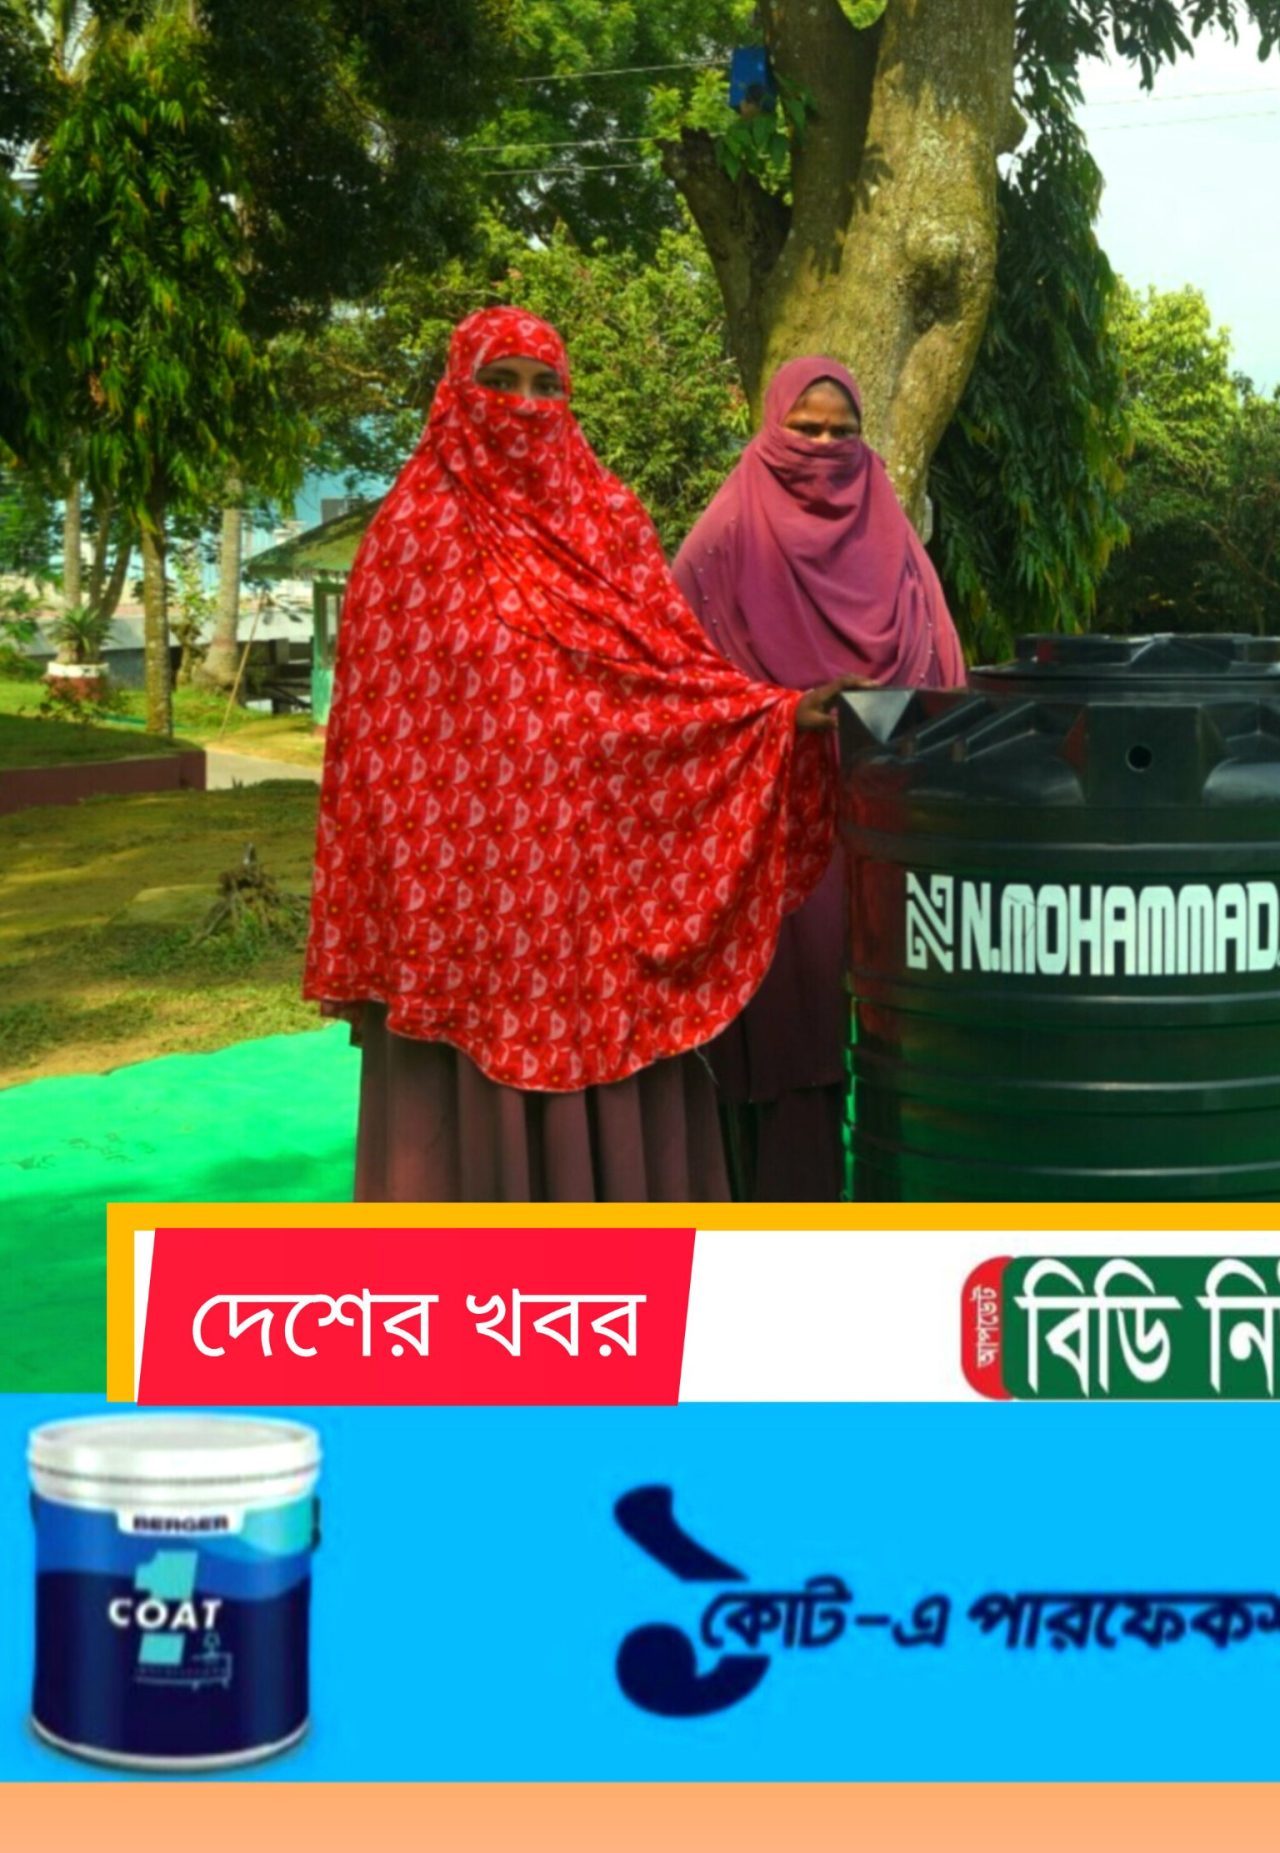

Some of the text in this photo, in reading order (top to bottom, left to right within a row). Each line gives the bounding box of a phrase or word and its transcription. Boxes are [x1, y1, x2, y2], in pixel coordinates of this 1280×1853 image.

[961, 880, 1280, 976] N.MOHAMMAD
[132, 1515, 229, 1531] BERGER
[108, 1599, 221, 1630] COAT
